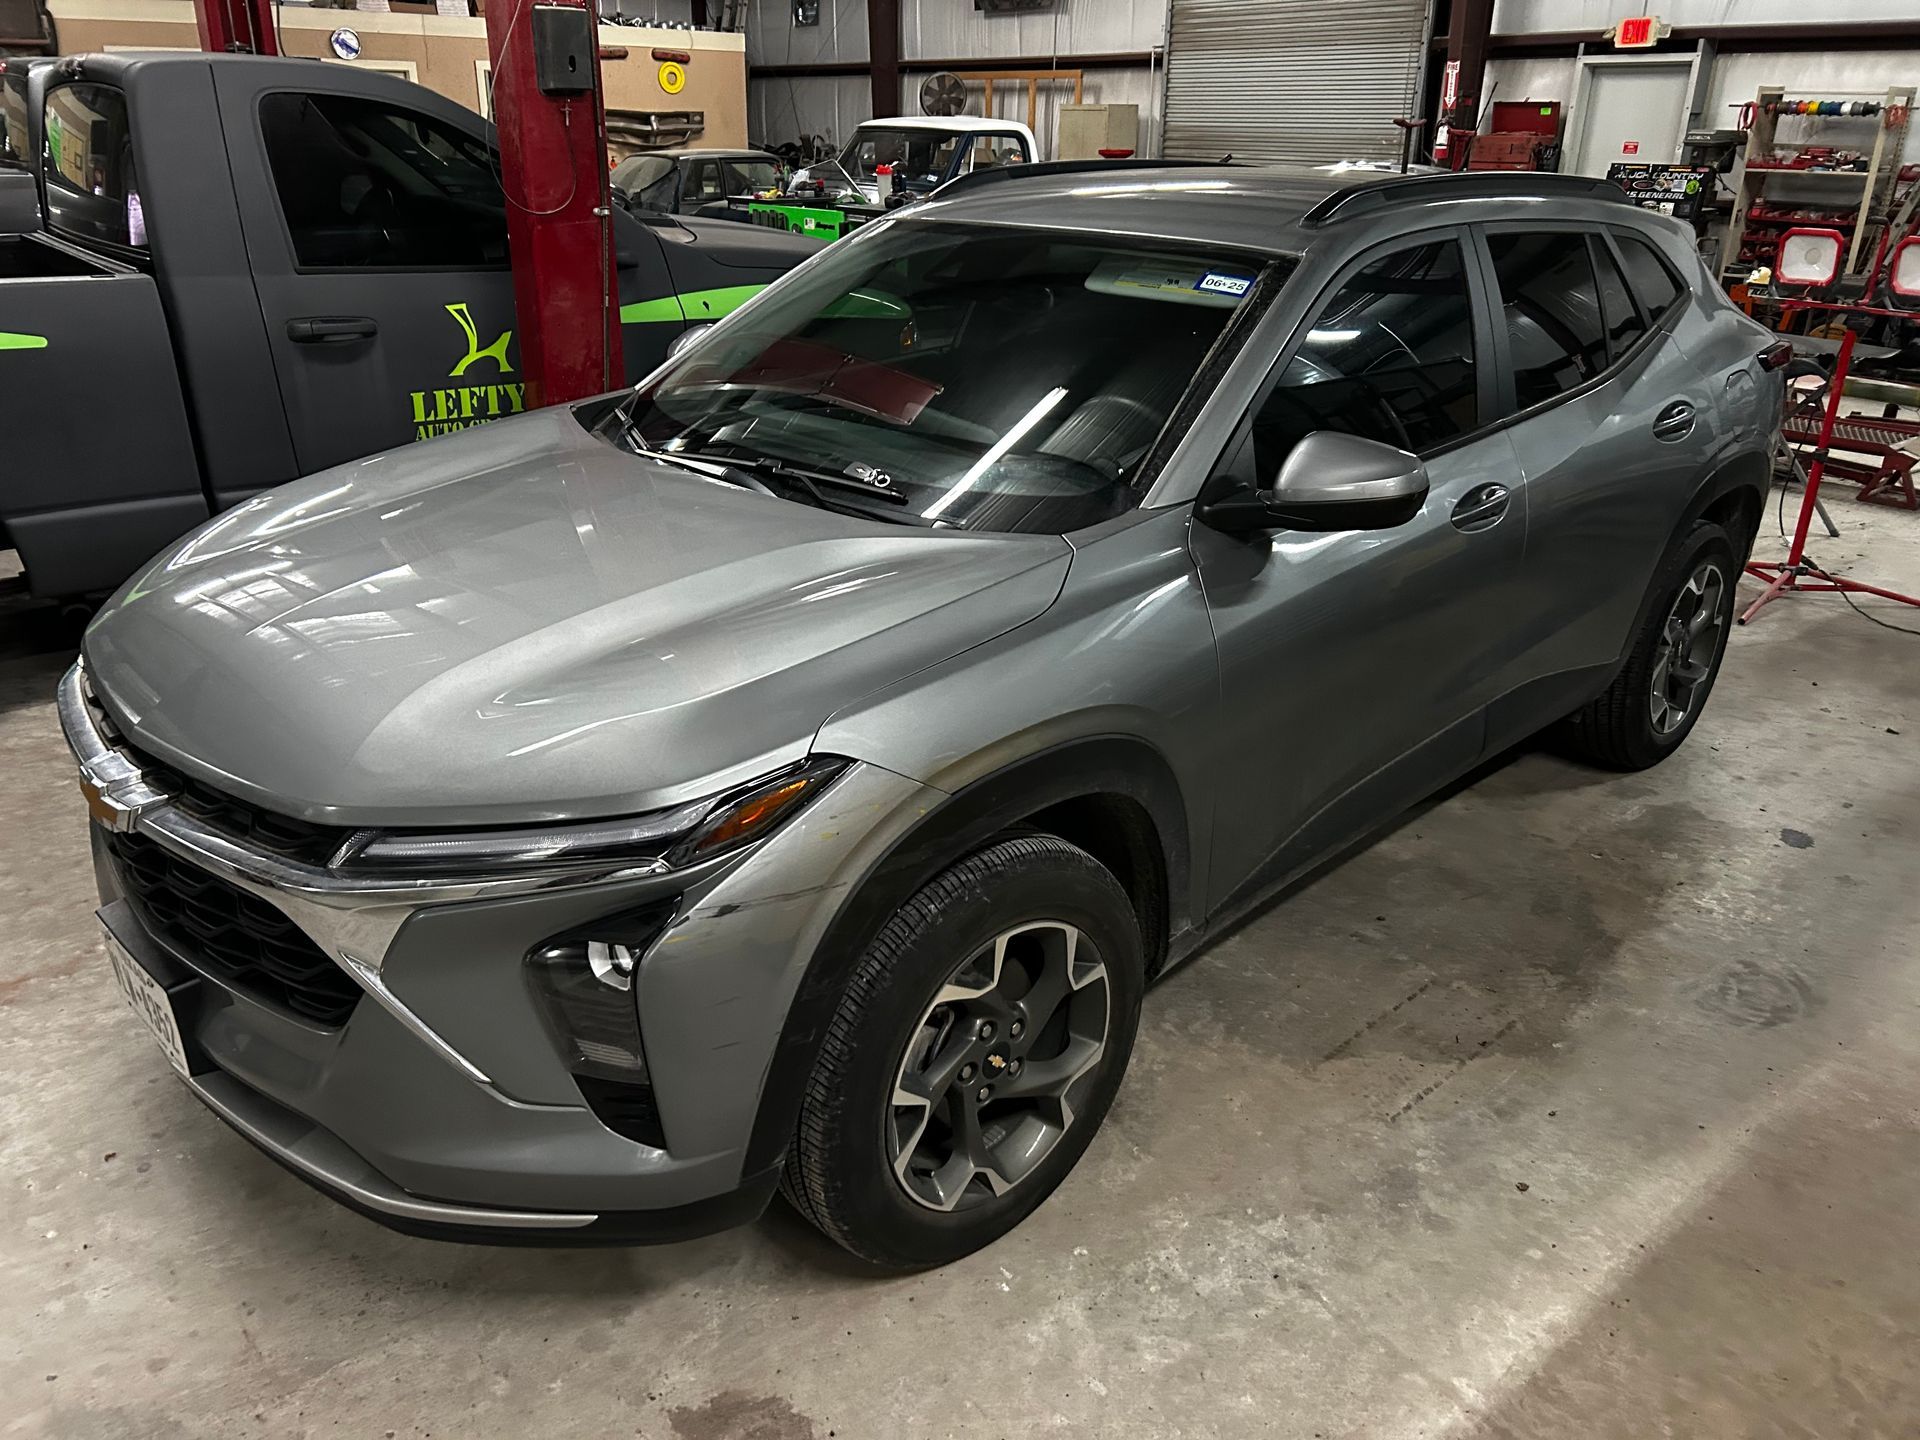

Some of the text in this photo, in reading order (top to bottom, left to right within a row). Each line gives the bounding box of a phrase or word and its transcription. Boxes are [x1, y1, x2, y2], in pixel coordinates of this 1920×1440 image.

[1621, 18, 1652, 45] EXIT
[1447, 63, 1459, 71] FIRE
[410, 383, 525, 422] LEFTY
